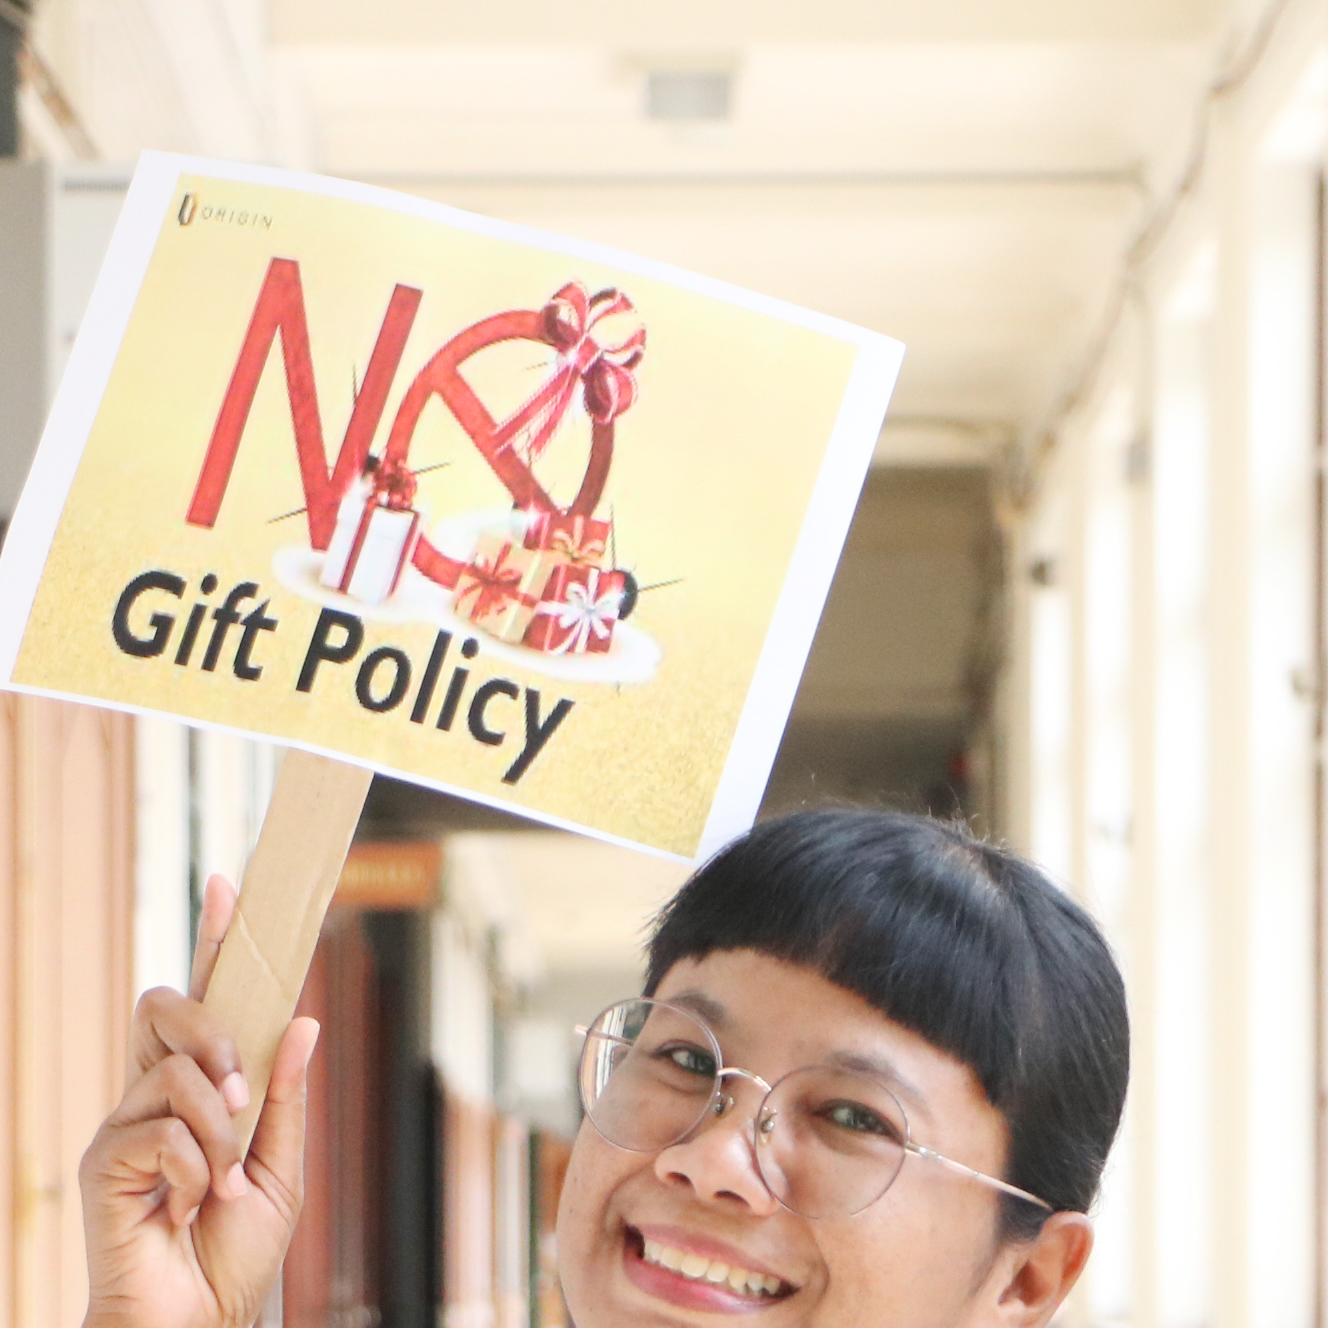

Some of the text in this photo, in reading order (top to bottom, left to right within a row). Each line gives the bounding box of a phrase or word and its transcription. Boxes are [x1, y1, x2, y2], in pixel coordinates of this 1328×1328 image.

[183, 256, 616, 590] NO
[110, 569, 576, 786] Gift Policy
